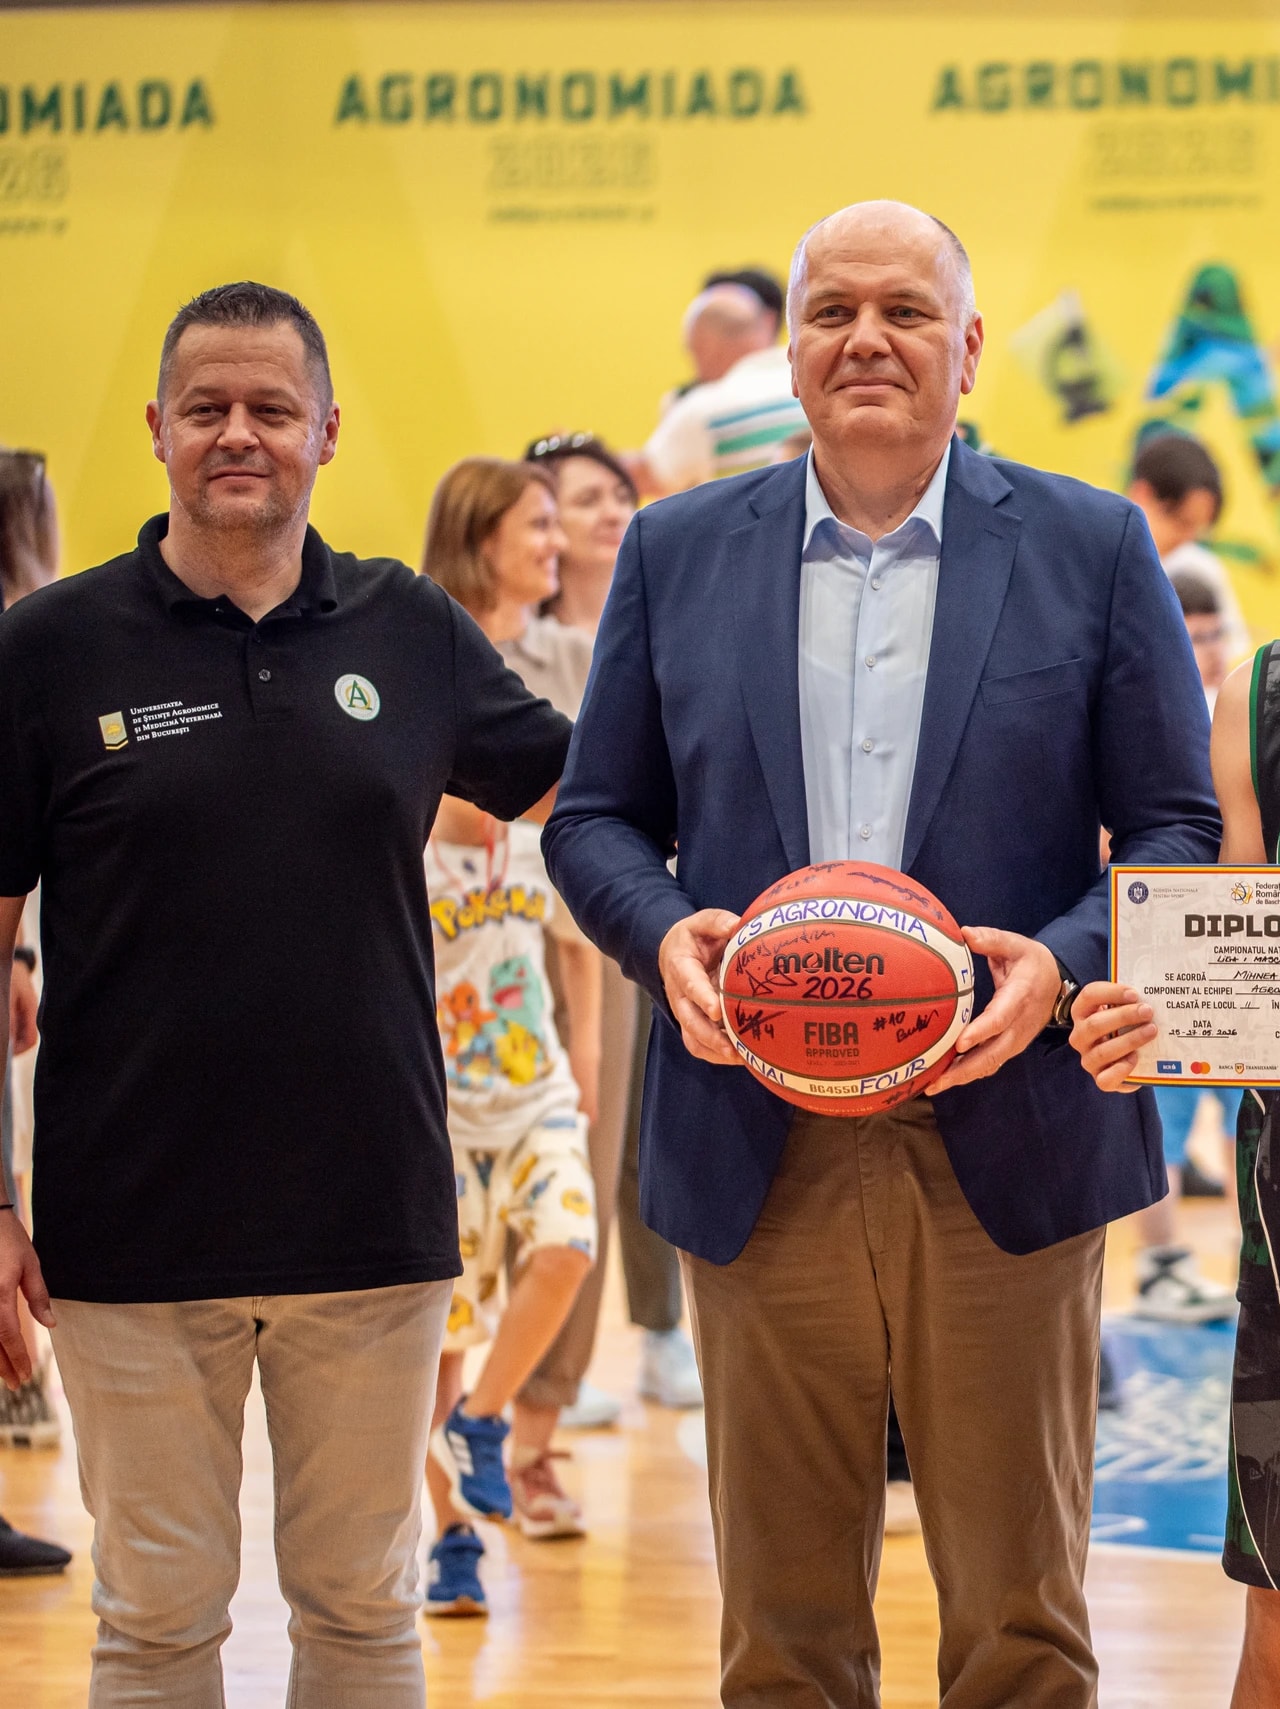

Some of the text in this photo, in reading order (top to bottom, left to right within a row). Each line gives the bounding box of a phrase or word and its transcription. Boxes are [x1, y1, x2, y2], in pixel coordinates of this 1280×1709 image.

[336, 66, 810, 126] AGRONOMIADA
[769, 899, 928, 943] AGRONOMIA
[1214, 946, 1265, 954] CAMPIONATUL
[773, 947, 885, 976] molten
[1165, 971, 1207, 981] SE ACORDĂ
[802, 976, 873, 1000] 2026
[1144, 986, 1233, 995] COMPONENT AL ECHIPEI
[1166, 999, 1237, 1009] CLASATĂ PE LOCUL
[1272, 999, 1280, 1009] ÎN
[1193, 1020, 1212, 1028] DATA
[804, 1021, 859, 1046] FIBA
[805, 1047, 860, 1058] APPROVED
[860, 1058, 928, 1095] FOUR
